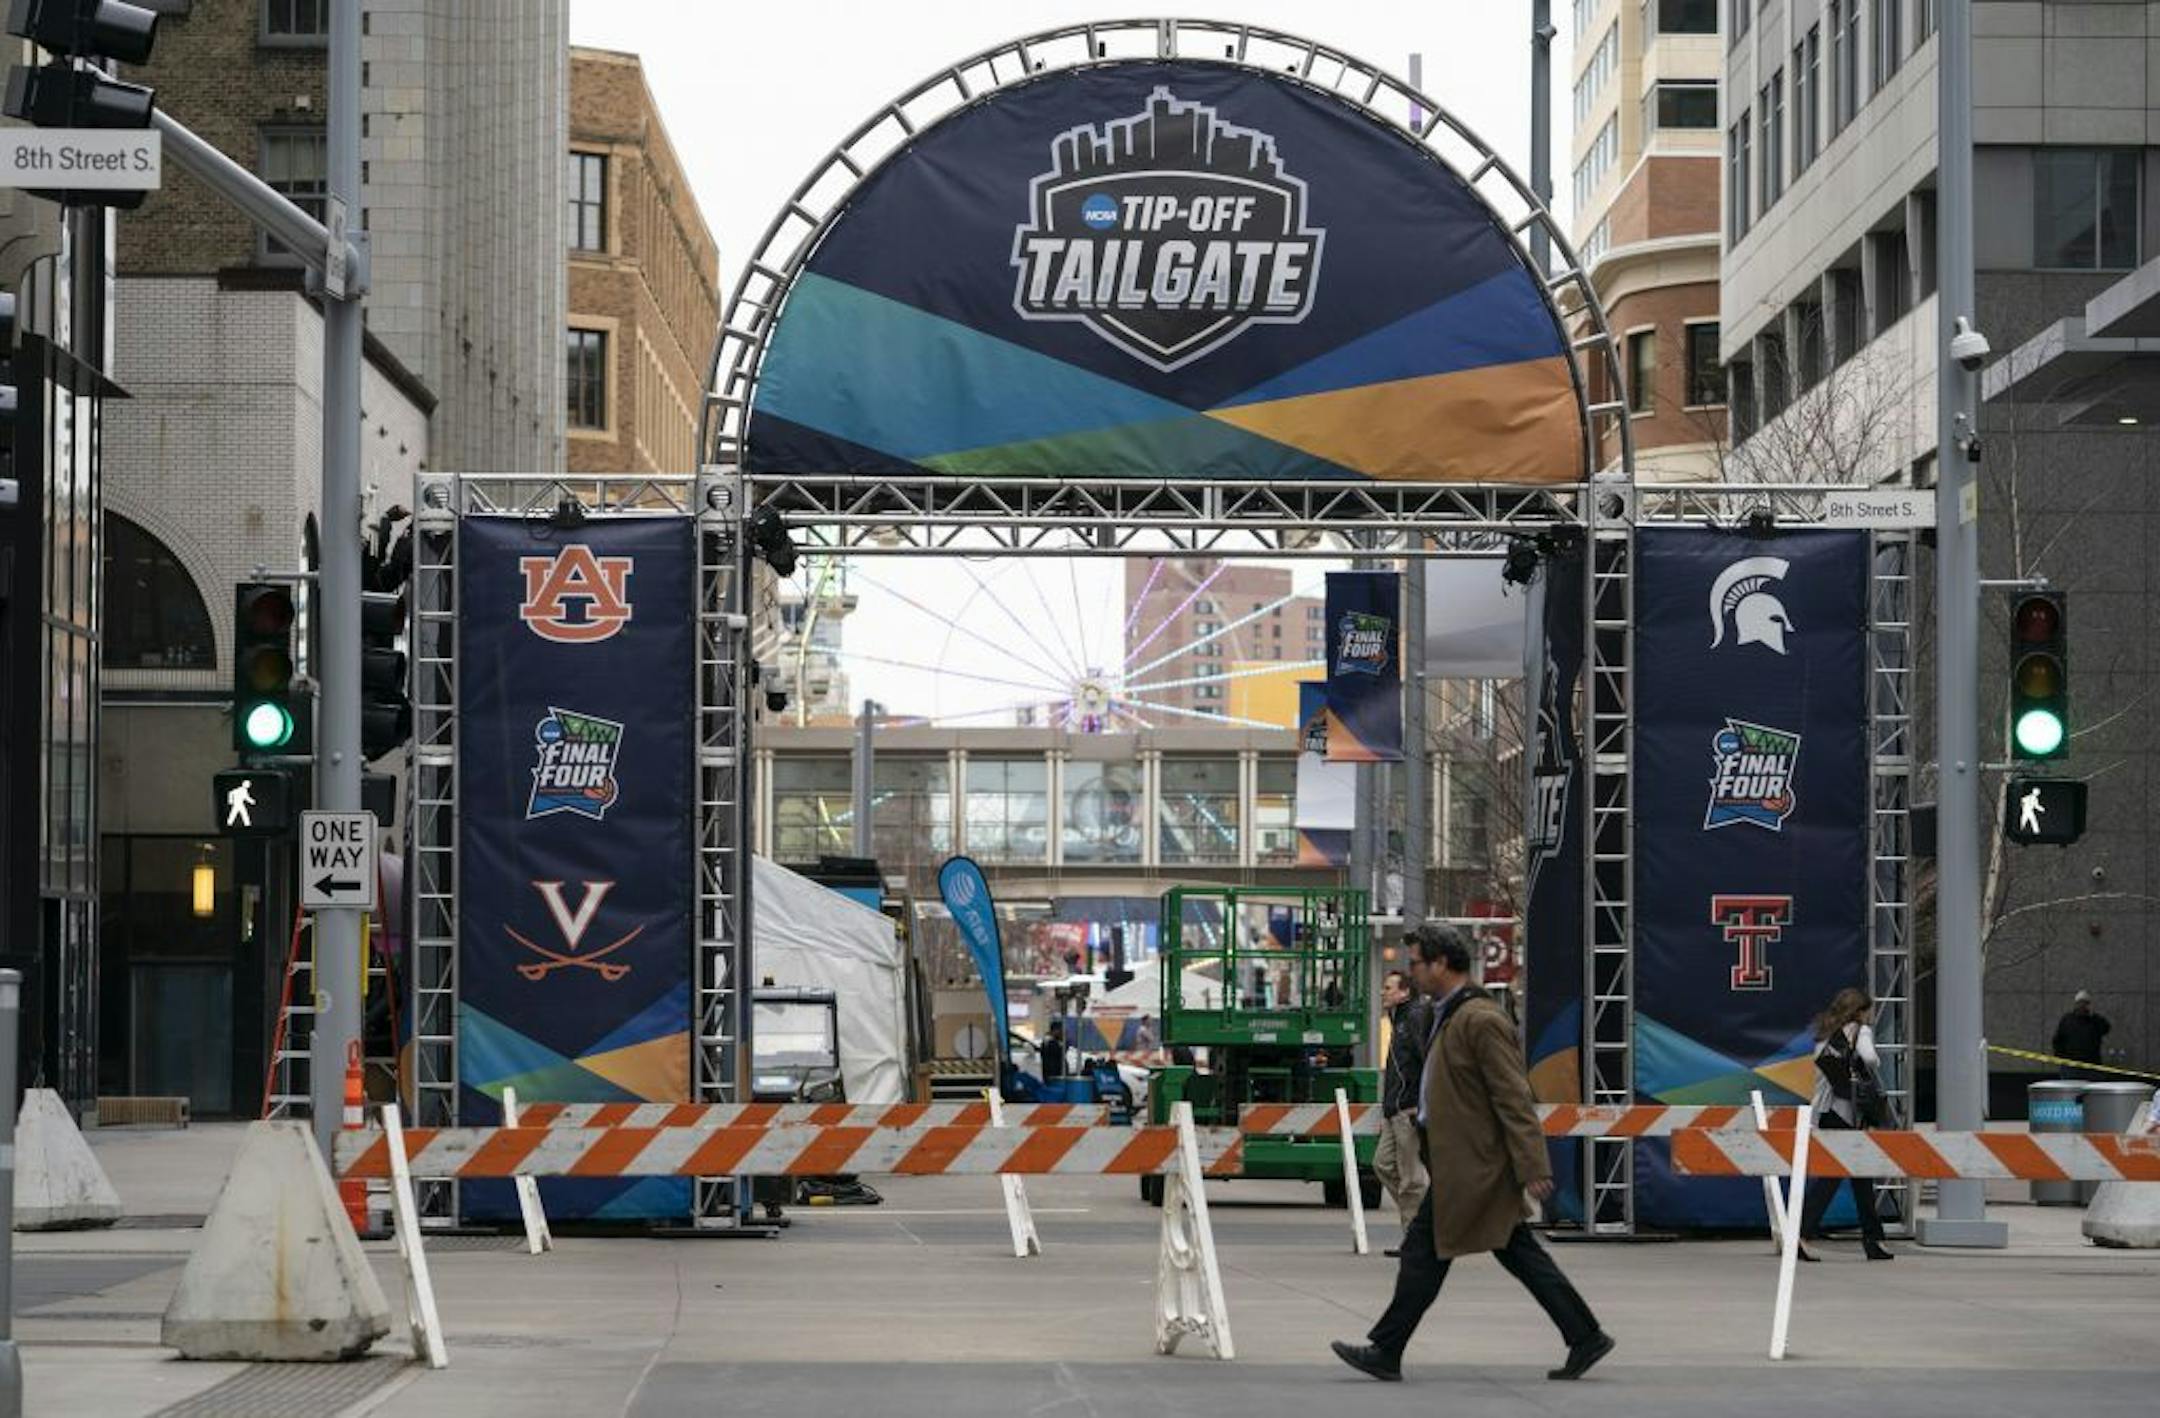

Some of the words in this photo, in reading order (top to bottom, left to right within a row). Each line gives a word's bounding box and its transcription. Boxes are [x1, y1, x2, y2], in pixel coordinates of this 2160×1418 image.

[15, 146, 52, 169] 8th
[59, 146, 126, 170] Street
[134, 148, 154, 171] S.
[1122, 196, 1256, 231] TIP-OFF
[1026, 238, 1310, 309] TAILGATE
[1830, 502, 1853, 518] 8th
[1857, 502, 1898, 517] Street
[1345, 632, 1383, 645] FINAL
[1343, 643, 1381, 658] FOUR
[544, 740, 610, 765] FINAL
[1722, 752, 1788, 776] FINAL
[540, 765, 607, 787] FOUR
[1718, 776, 1784, 799] FOUR
[312, 821, 363, 842] ONE
[310, 846, 363, 868] WAY
